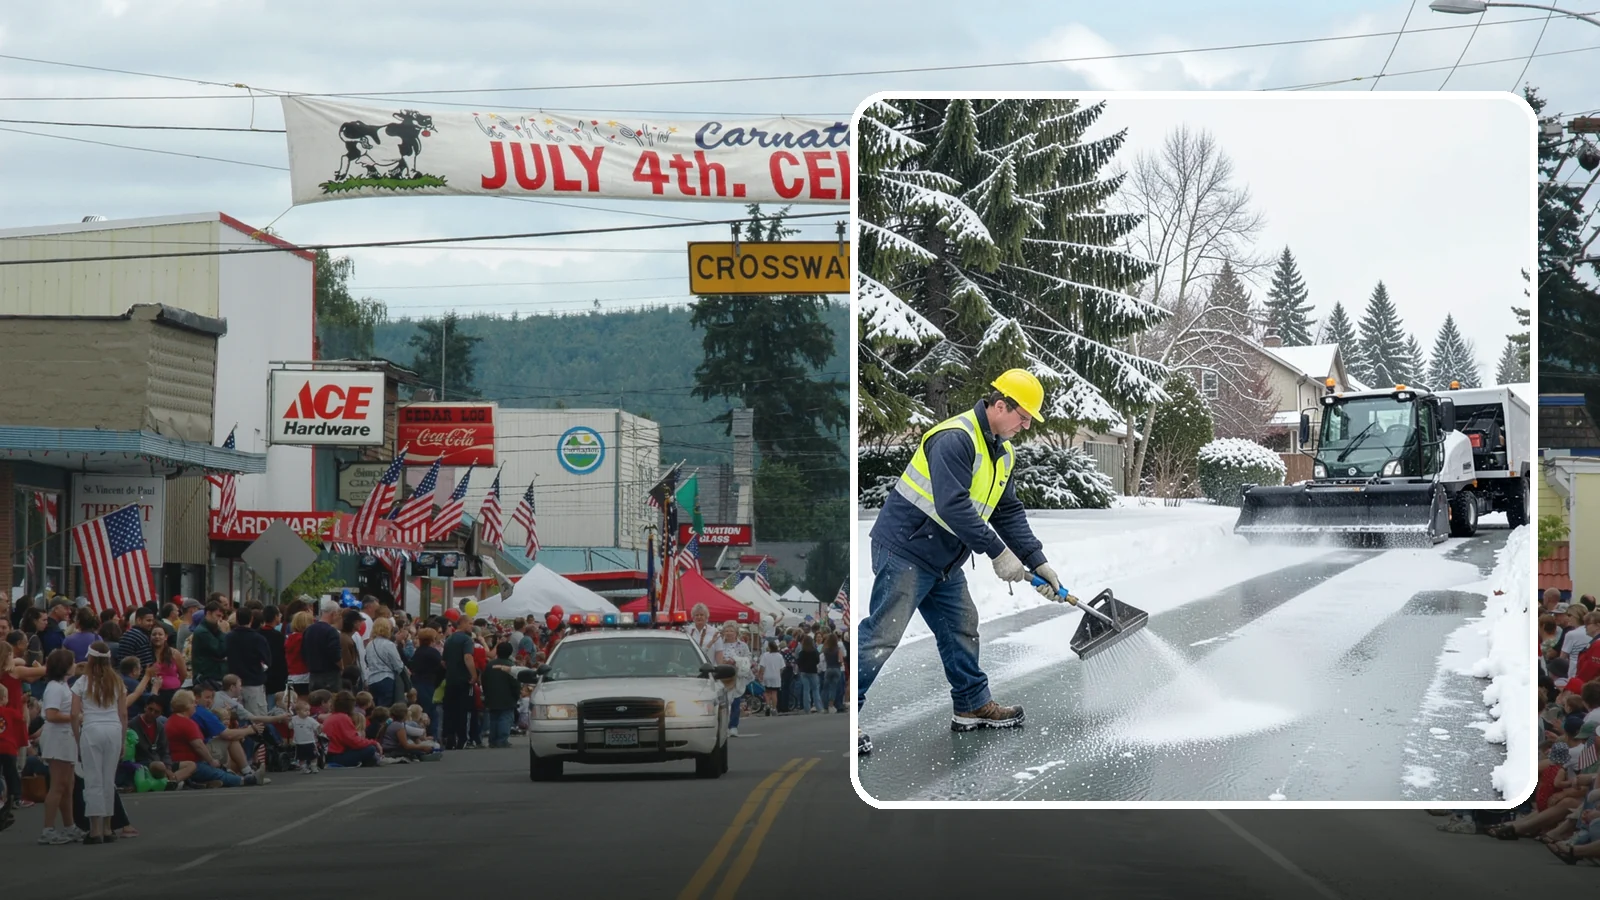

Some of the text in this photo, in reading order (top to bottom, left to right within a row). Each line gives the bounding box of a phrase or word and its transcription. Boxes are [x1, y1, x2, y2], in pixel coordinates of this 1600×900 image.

[481, 141, 605, 192] JULY
[632, 150, 747, 198] 4th.
[696, 254, 850, 280] CROSSWA
[282, 380, 373, 420] ACE
[405, 409, 486, 422] CEDAR LOG
[283, 421, 371, 436] Hardware
[416, 428, 477, 447] Coca-Cola
[353, 467, 386, 480] Simpl
[83, 485, 155, 495] St. Vincent de Paul
[213, 516, 331, 535] HARDARE
[688, 526, 742, 535] CRNATION
[699, 535, 730, 543] GLASS
